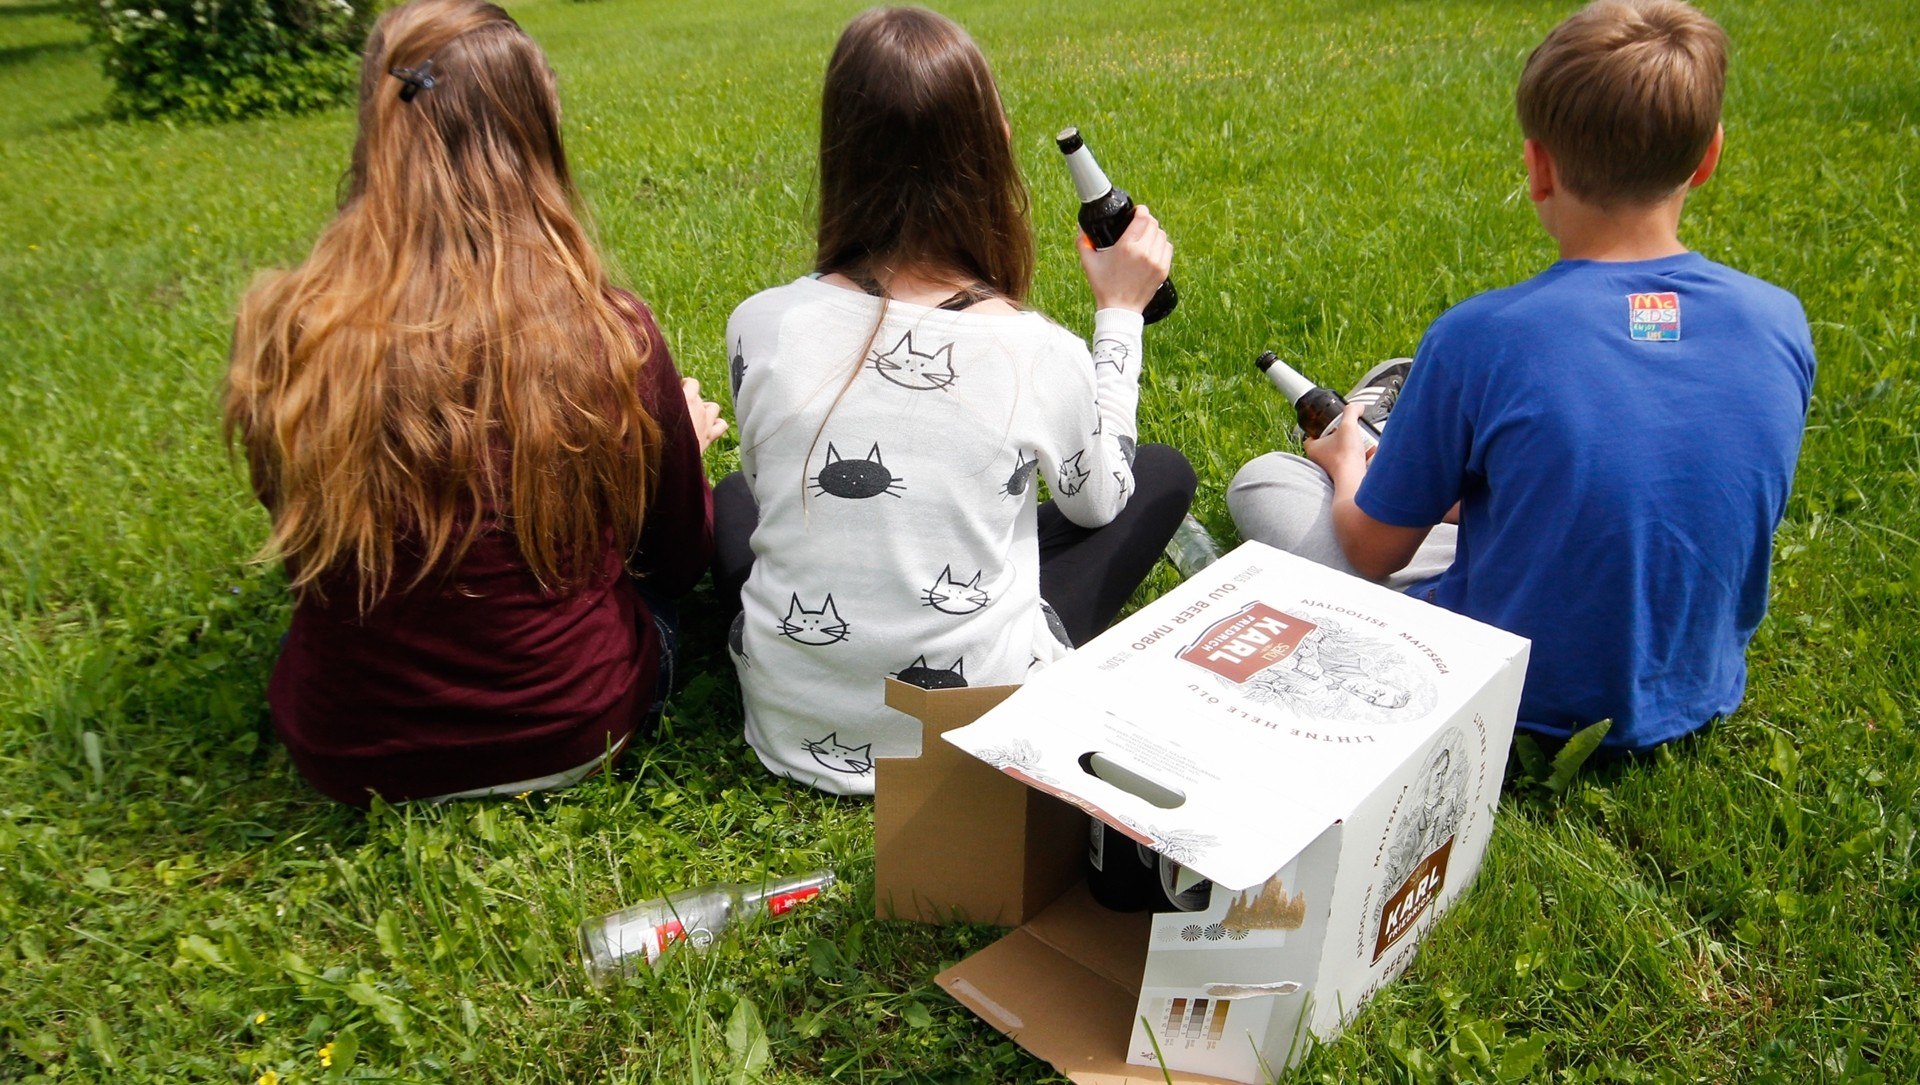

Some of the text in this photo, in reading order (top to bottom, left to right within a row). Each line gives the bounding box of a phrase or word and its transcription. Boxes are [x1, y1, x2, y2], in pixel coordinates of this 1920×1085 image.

[1634, 295, 1674, 309] Mc
[1172, 600, 1211, 624] BEER
[1208, 583, 1238, 601] ÕLU
[1132, 624, 1174, 651] ПИВО
[1201, 614, 1256, 652] FRIEDRICH
[1207, 615, 1290, 665] KARL
[1301, 598, 1450, 676] AJALOOLISE MAITSEGA
[1188, 683, 1376, 745] LIHTNE HELE ÕLU
[1373, 784, 1409, 868] MAITSEGA
[1385, 865, 1440, 933] KARL
[1386, 893, 1434, 943] FRIEDRICH
[1382, 943, 1411, 980] BEER
